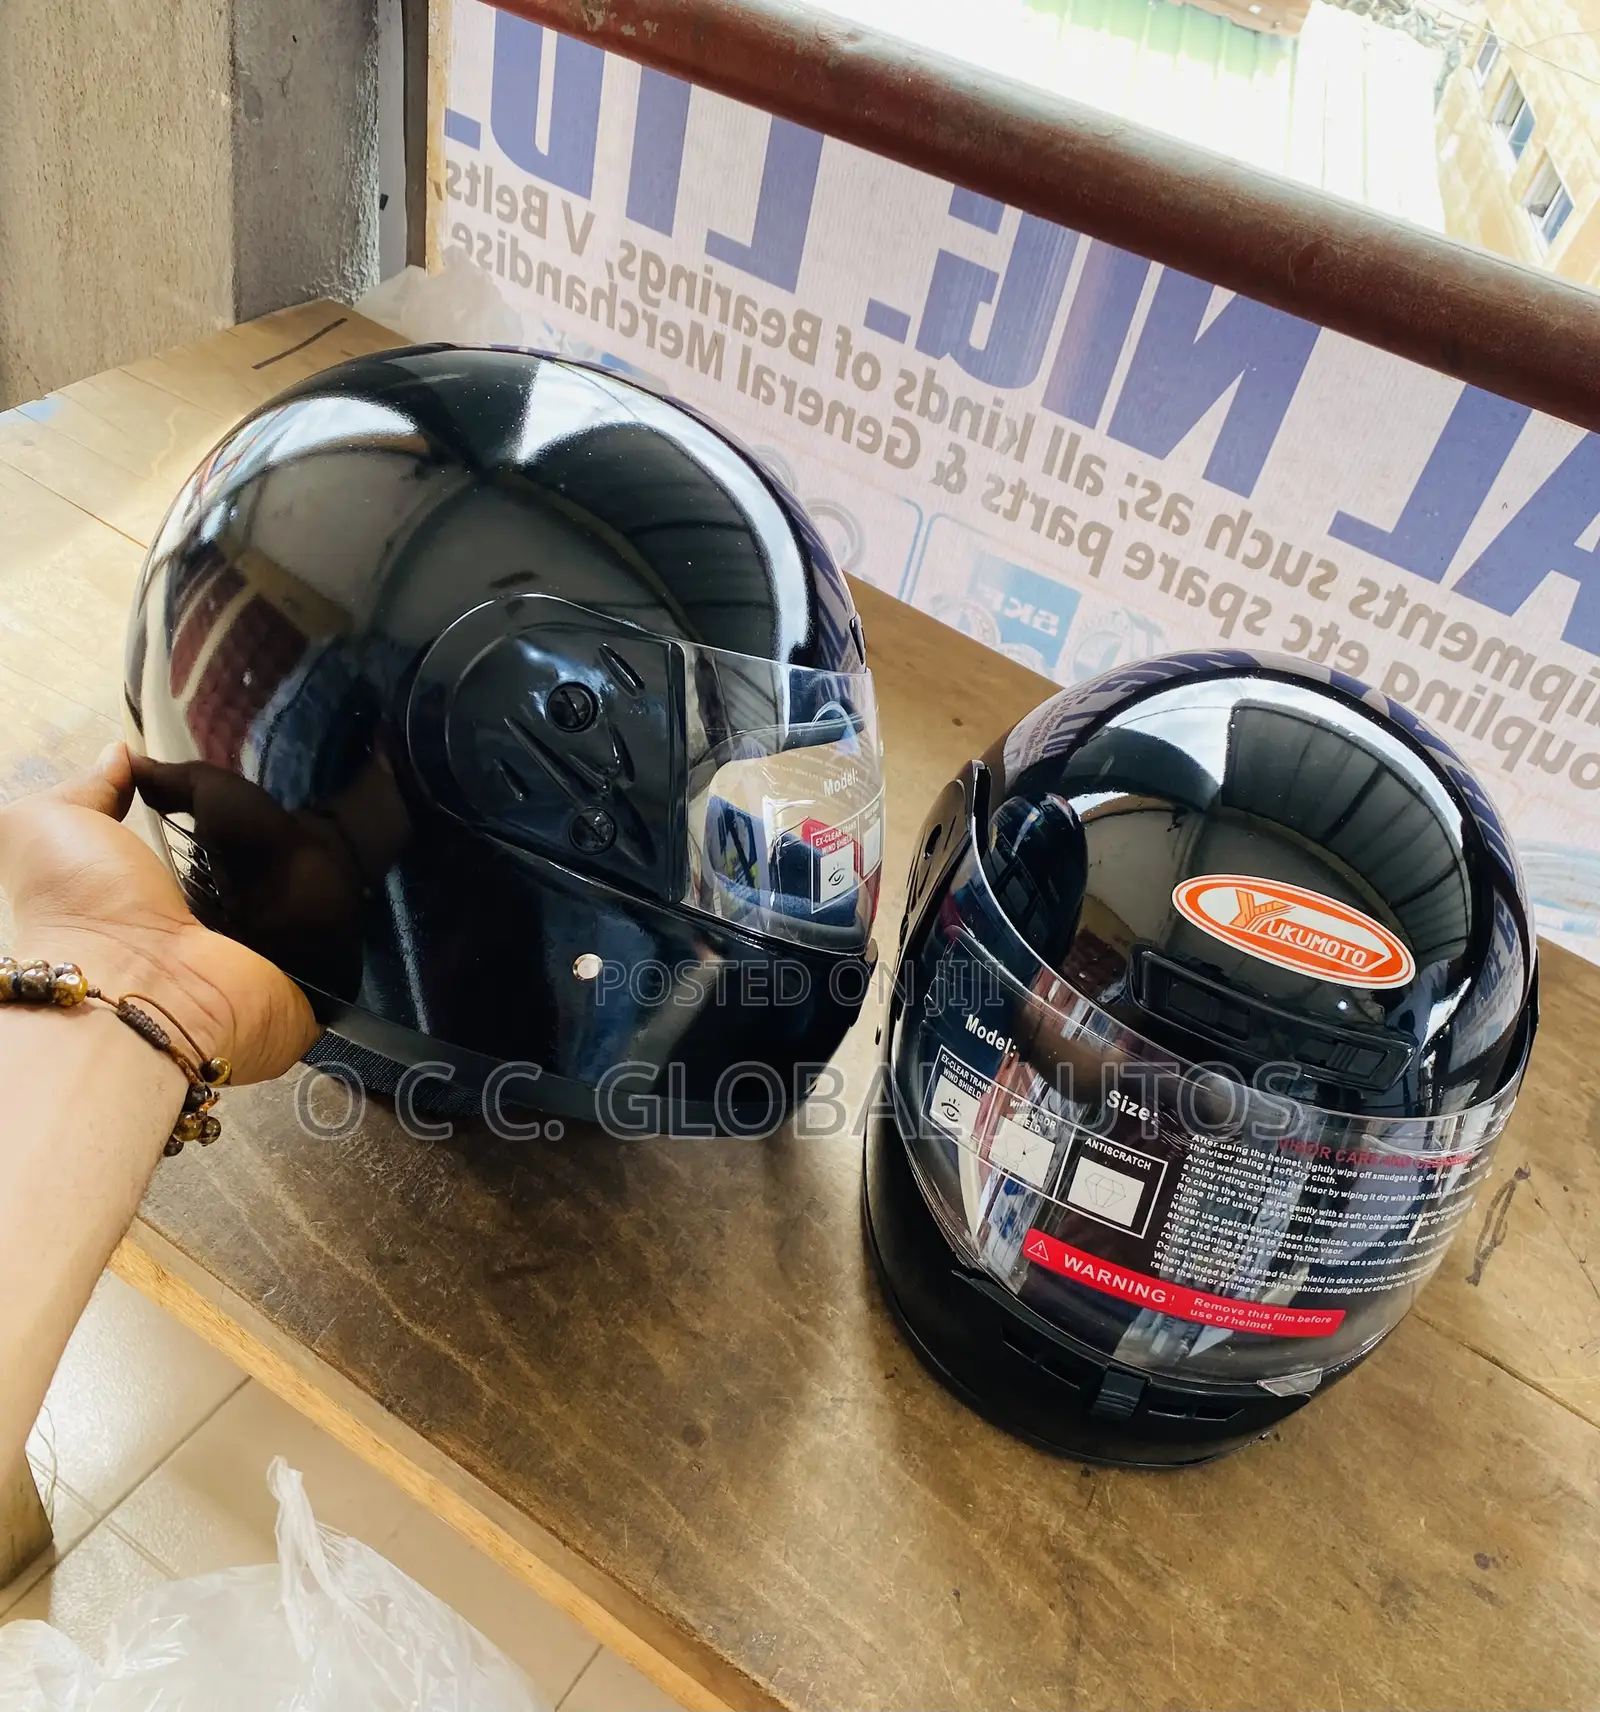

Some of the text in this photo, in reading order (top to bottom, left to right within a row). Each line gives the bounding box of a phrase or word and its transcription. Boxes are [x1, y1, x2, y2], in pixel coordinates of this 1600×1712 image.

[823, 768, 859, 796] Model:
[1229, 889, 1367, 967] YUKUMOTO
[965, 1014, 1017, 1057] Model:
[941, 1054, 992, 1094] EX-CLEAR TRANS
[943, 1067, 982, 1099] WIND SHIELD
[1106, 1089, 1158, 1125] Size:
[1085, 1137, 1151, 1171] ANTISCRATCH
[1190, 1143, 1205, 1154] the
[1209, 1149, 1234, 1161] visor
[1236, 1157, 1264, 1170] using
[1273, 1166, 1293, 1176] soft
[1294, 1170, 1310, 1181] dry
[1312, 1174, 1337, 1185] cloth.
[1192, 1135, 1218, 1148] After
[1220, 1142, 1249, 1155] using
[1251, 1148, 1266, 1159] the
[1268, 1153, 1303, 1169] helmet,
[1306, 1162, 1336, 1175] lightly
[1337, 1168, 1358, 1178] wipe
[1359, 1172, 1372, 1180] off
[1373, 1172, 1408, 1182] smudges
[1180, 1173, 1191, 1183] To
[1193, 1179, 1219, 1192] clean
[1221, 1187, 1236, 1197] the
[1238, 1191, 1264, 1205] visor,
[1266, 1199, 1287, 1210] wipe
[1289, 1204, 1317, 1216] gently
[1319, 1209, 1337, 1217] with
[1344, 1212, 1360, 1220] soft
[1362, 1213, 1381, 1221] cloth
[1186, 1154, 1215, 1168] Avoid
[1217, 1164, 1272, 1183] watermarks
[1288, 1182, 1301, 1190] the
[1304, 1185, 1327, 1194] visor
[1329, 1188, 1340, 1198] by
[1341, 1191, 1368, 1201] wiping
[1377, 1194, 1389, 1202] dry
[1191, 1168, 1216, 1180] rainy
[1218, 1174, 1246, 1188] riding
[1248, 1181, 1295, 1199] condition.
[1174, 1193, 1200, 1207] cloth.
[1176, 1182, 1204, 1197] Rinse
[1207, 1192, 1215, 1200] if
[1216, 1195, 1231, 1206] off
[1232, 1201, 1259, 1215] using
[1269, 1209, 1287, 1218] soft
[1290, 1214, 1312, 1224] cloth
[1315, 1217, 1348, 1228] damped
[1349, 1221, 1366, 1229] with
[1163, 1222, 1189, 1235] After
[1190, 1230, 1233, 1248] cleaning
[1247, 1246, 1263, 1254] use
[1277, 1251, 1292, 1260] the
[1293, 1254, 1325, 1265] helmet,
[1167, 1211, 1210, 1230] abrasive
[1212, 1224, 1265, 1243] detergents
[1278, 1241, 1303, 1251] clean
[1304, 1245, 1318, 1253] the
[1320, 1247, 1343, 1256] visor.
[1170, 1201, 1200, 1216] Never
[1202, 1211, 1219, 1222] use
[1221, 1218, 1302, 1241] petroleum-based
[1304, 1236, 1350, 1247] chemicals,
[1156, 1240, 1170, 1251] Do
[1172, 1248, 1189, 1257] not
[1190, 1252, 1213, 1263] wear
[1215, 1258, 1237, 1269] dark
[1250, 1266, 1278, 1278] tinted
[1336, 1277, 1354, 1285] dark
[1160, 1231, 1255, 1262] rolled and dropped.
[1150, 1261, 1258, 1294] raise the visor at times.
[1154, 1251, 1181, 1266] When
[1182, 1260, 1219, 1276] blinded
[1221, 1271, 1232, 1281] by
[1234, 1273, 1291, 1291] approaching
[1189, 1308, 1275, 1332] use of helmet.
[1193, 1297, 1332, 1324] Remove this film before
